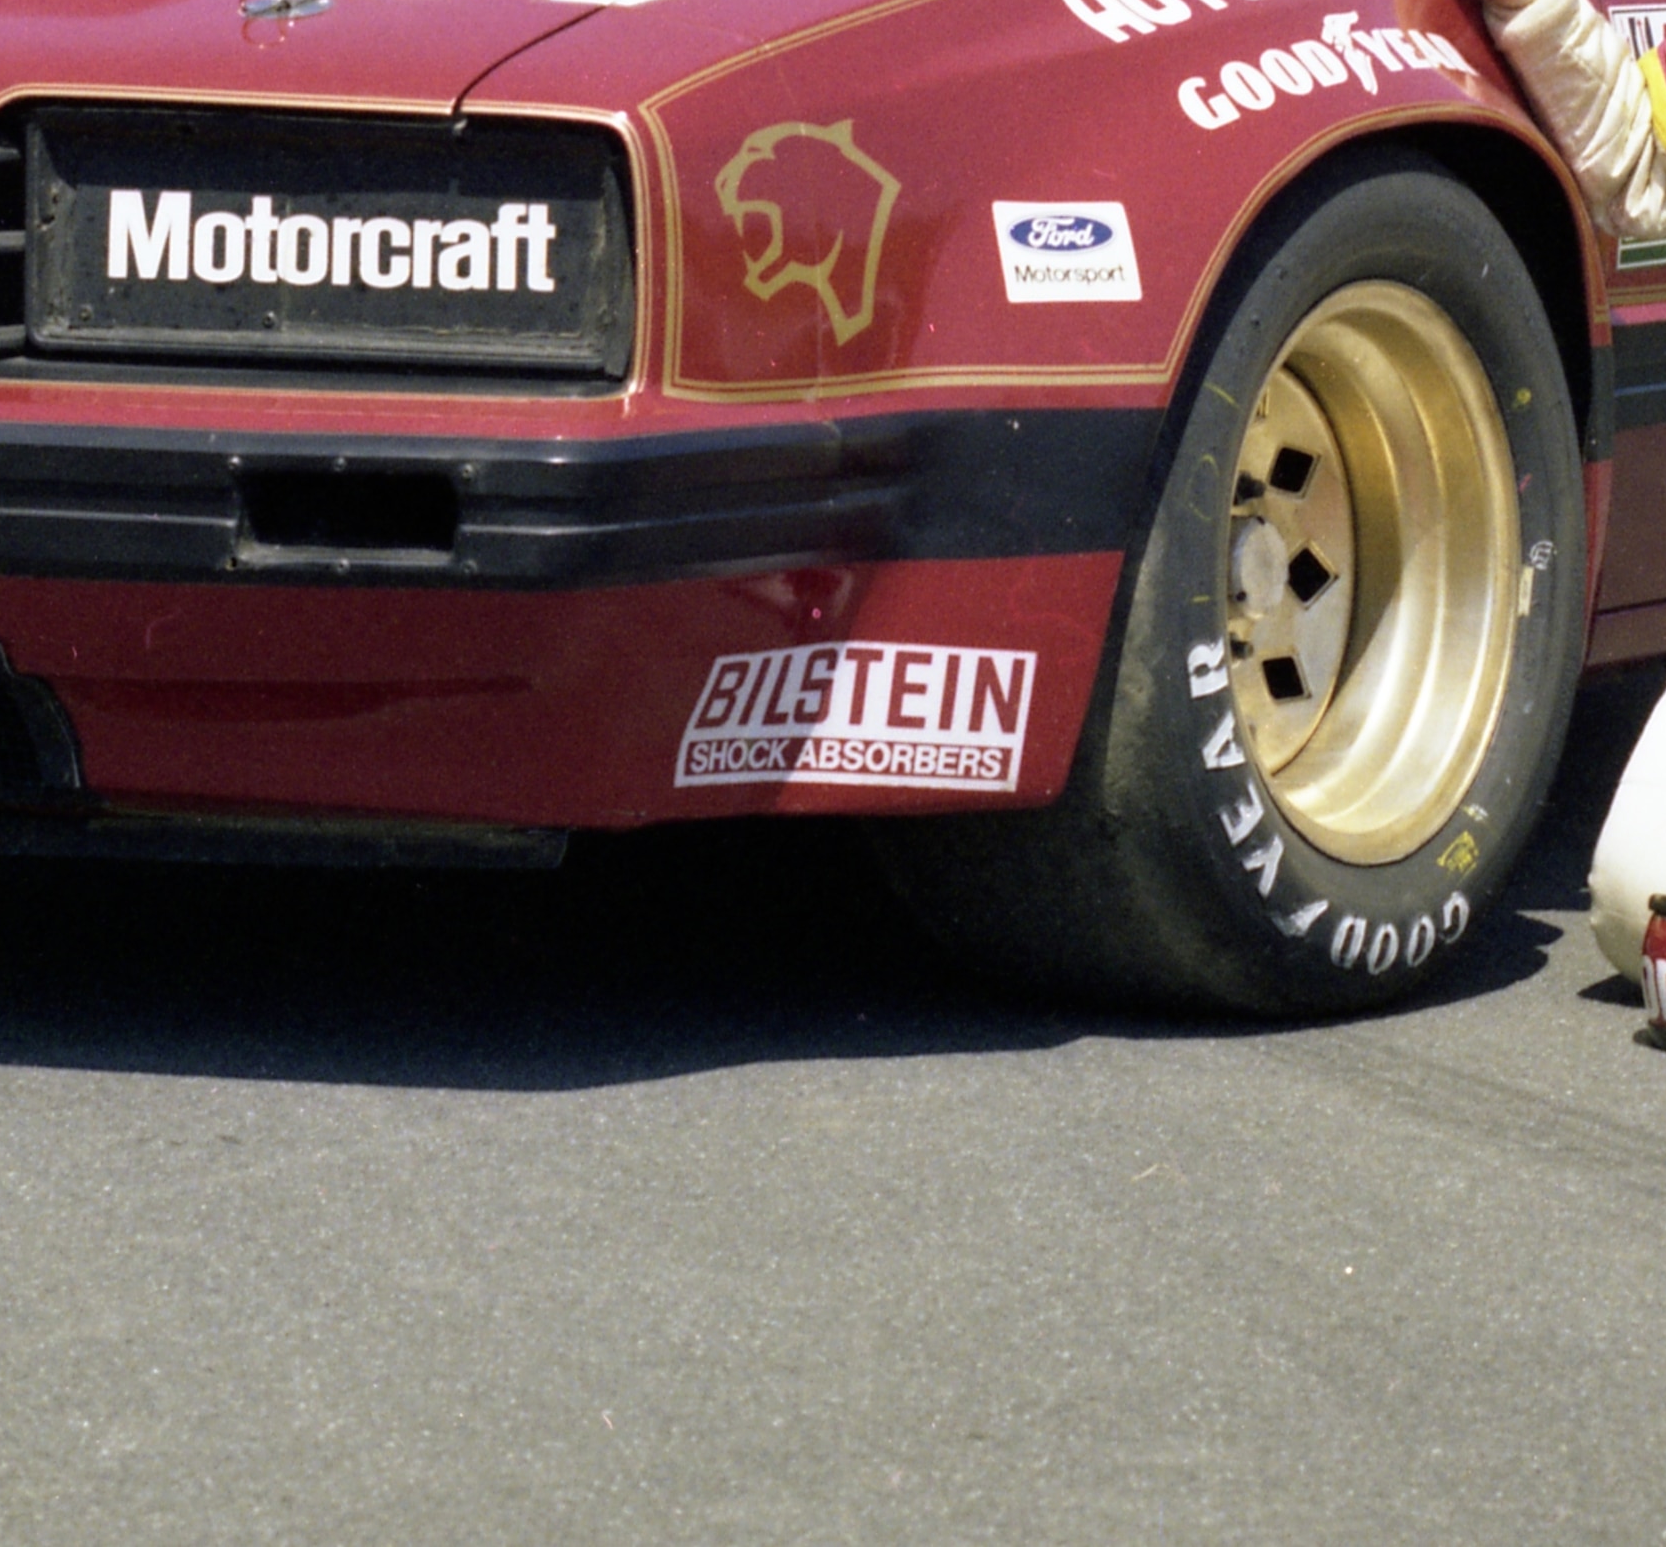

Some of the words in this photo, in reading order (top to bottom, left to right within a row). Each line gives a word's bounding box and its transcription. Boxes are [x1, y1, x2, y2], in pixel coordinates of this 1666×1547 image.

[1178, 25, 1480, 130] GOODYEAR
[106, 189, 556, 292] Motorcraft
[1014, 265, 1125, 285] Motorsport
[1027, 216, 1095, 248] Ford
[693, 648, 1026, 734] BILSTEIN
[689, 739, 790, 773] SHOCK
[796, 739, 1003, 779] ABSORBERS
[1187, 637, 1470, 975] GOODYEAR
